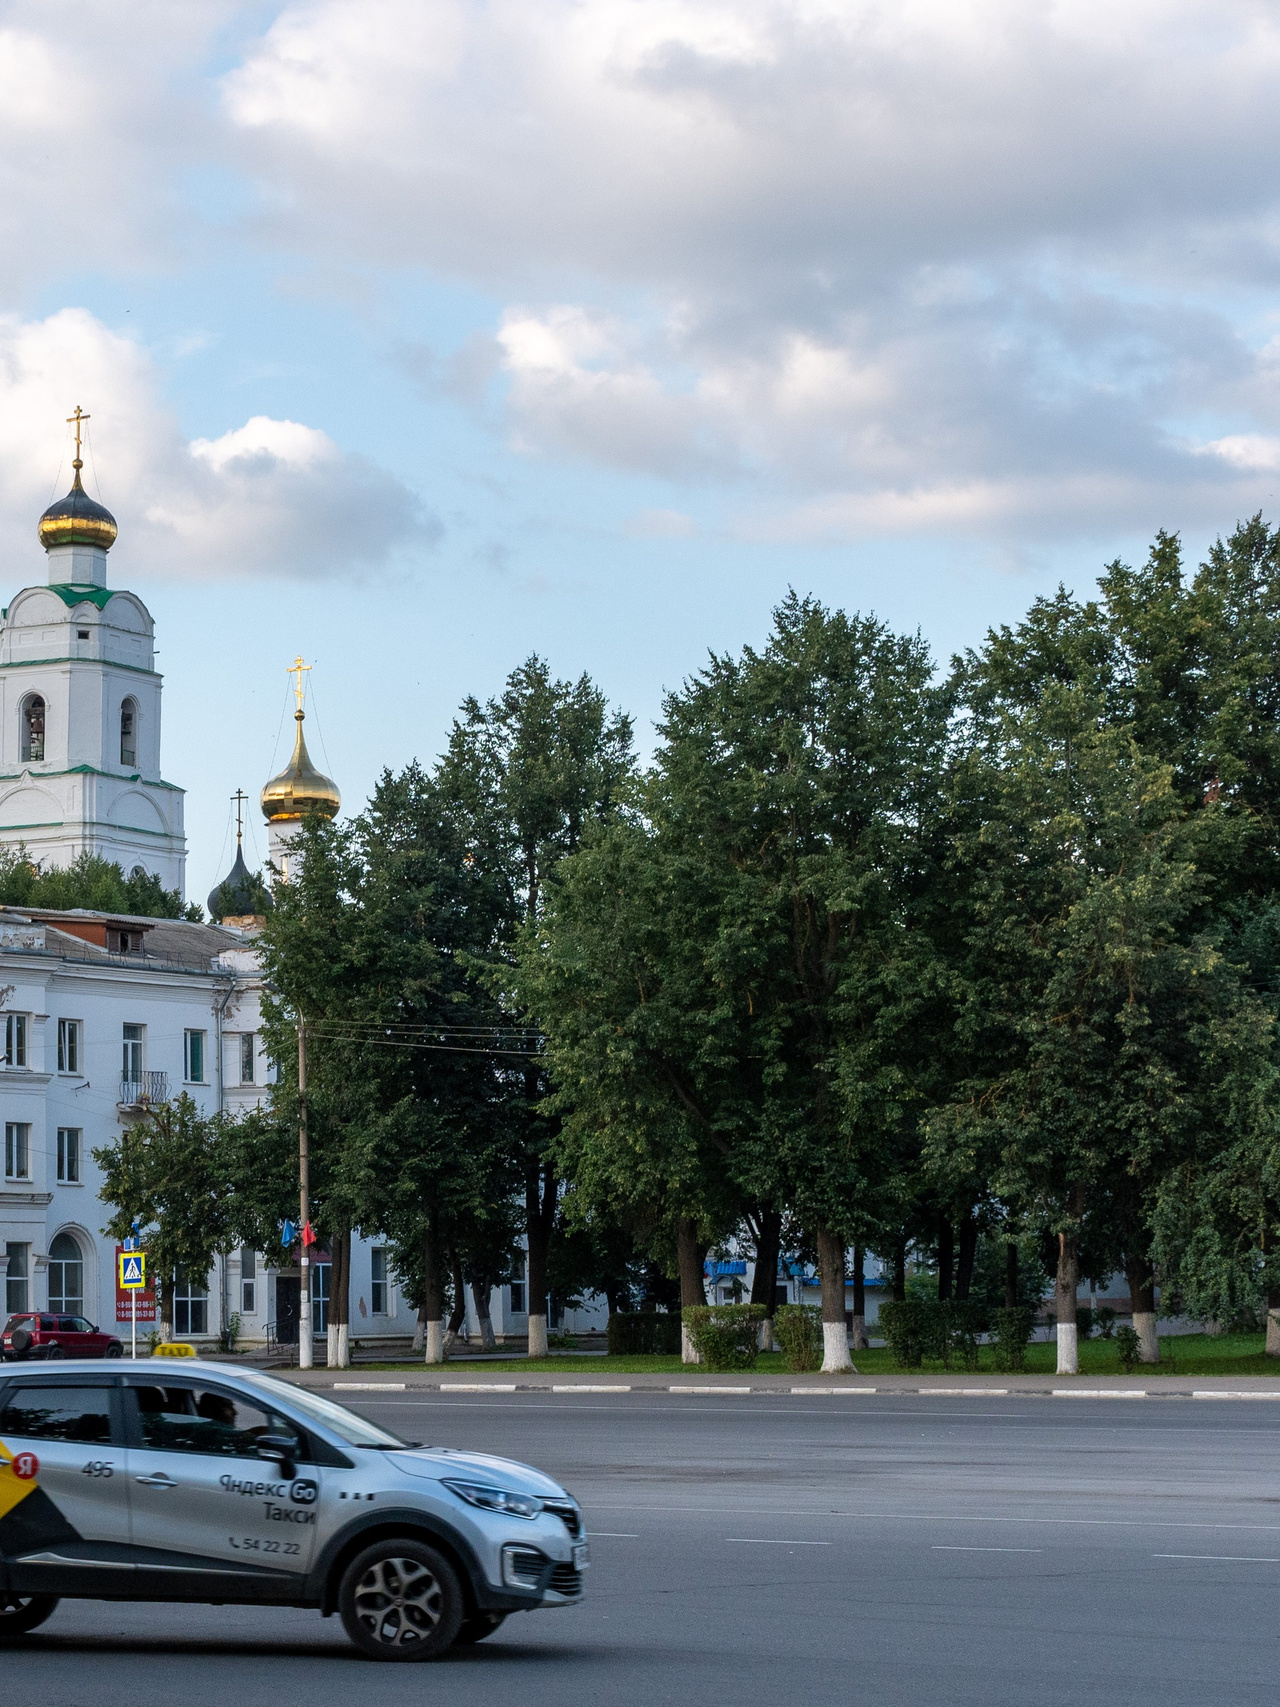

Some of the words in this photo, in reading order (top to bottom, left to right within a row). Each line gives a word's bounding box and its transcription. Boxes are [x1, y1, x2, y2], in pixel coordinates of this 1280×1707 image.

[81, 1460, 114, 1478] 495
[219, 1474, 287, 1498] Яндекс
[291, 1482, 316, 1501] Go
[263, 1501, 317, 1525] Такси
[242, 1538, 260, 1550] 54
[263, 1540, 280, 1553] 22
[283, 1542, 301, 1555] 22
